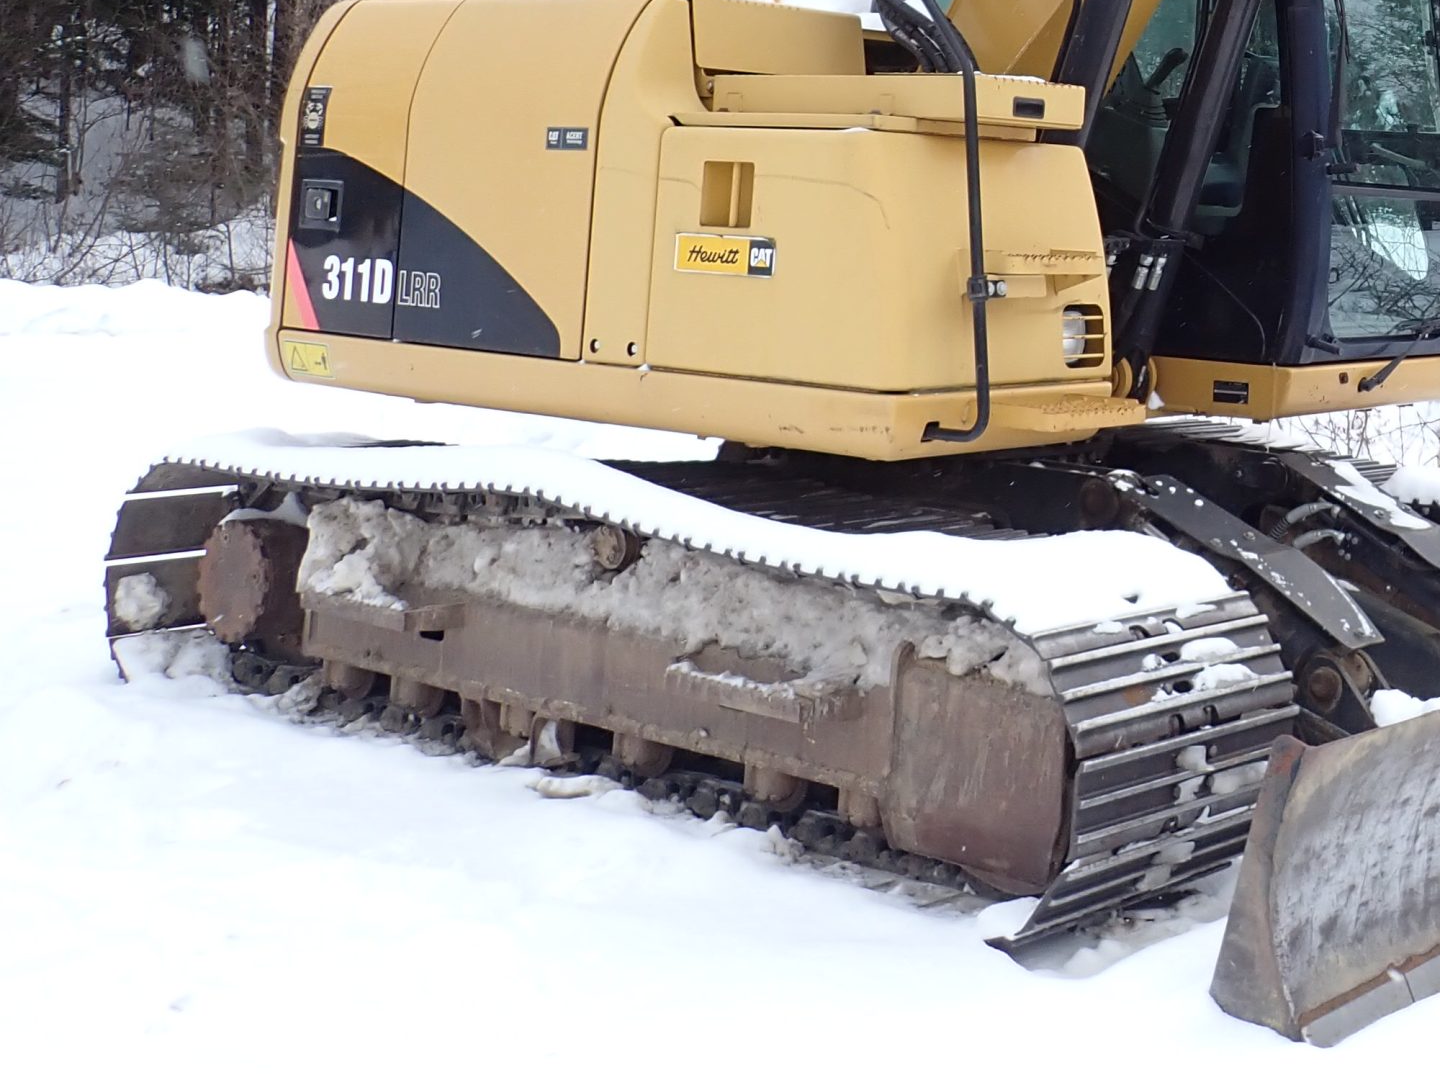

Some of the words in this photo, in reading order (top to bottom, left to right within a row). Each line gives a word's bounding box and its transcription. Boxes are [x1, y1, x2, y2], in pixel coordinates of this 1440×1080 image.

[687, 245, 740, 264] Hewitt
[750, 247, 773, 267] CAT
[322, 254, 394, 304] 311D
[397, 270, 441, 309] LRR
